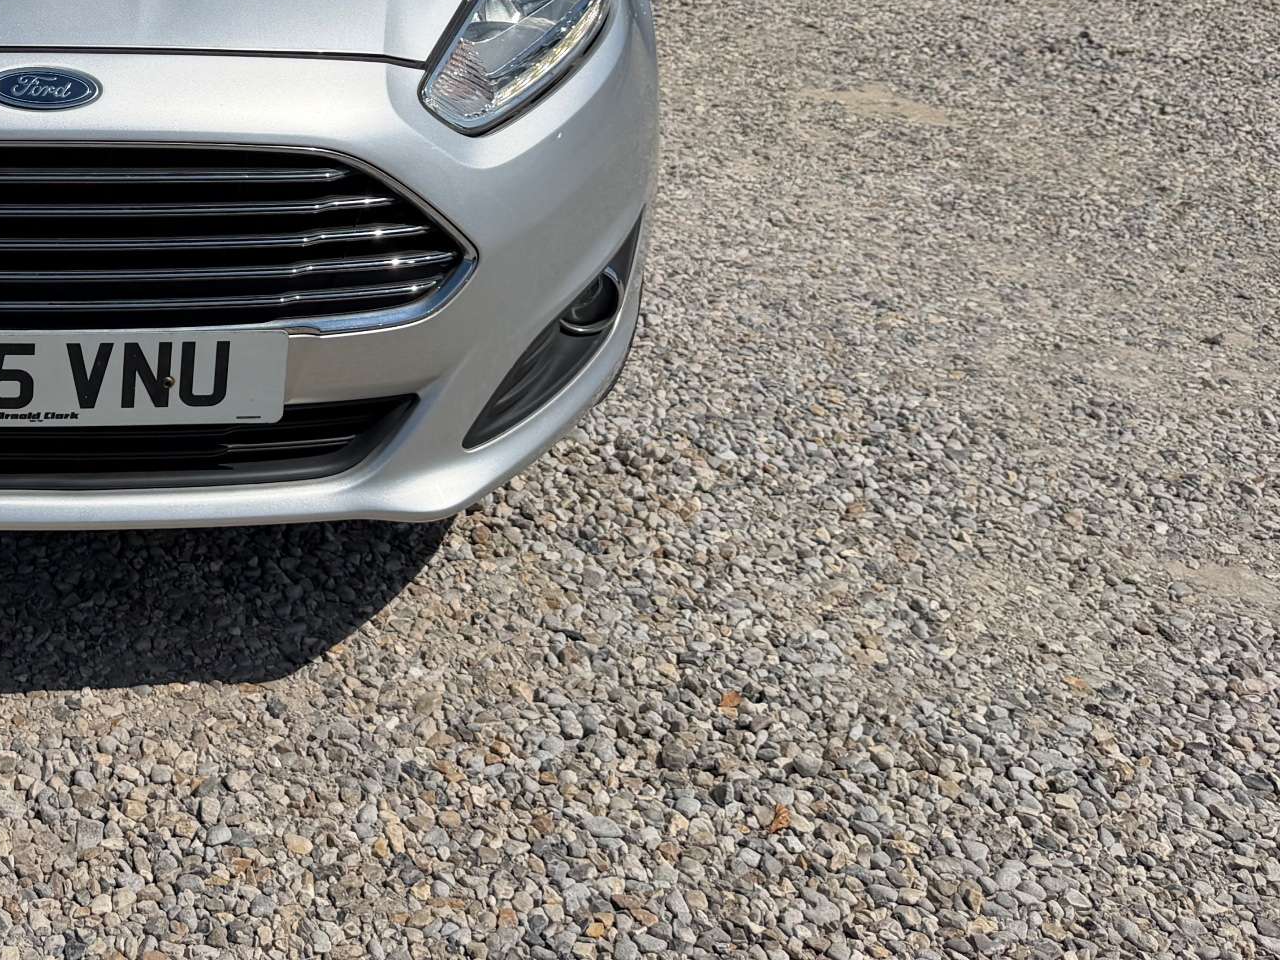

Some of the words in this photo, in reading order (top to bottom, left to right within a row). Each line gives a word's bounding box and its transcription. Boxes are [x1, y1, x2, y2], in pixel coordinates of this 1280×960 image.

[11, 74, 72, 98] Ford
[66, 340, 231, 410] VNU
[43, 411, 80, 420] Clark
